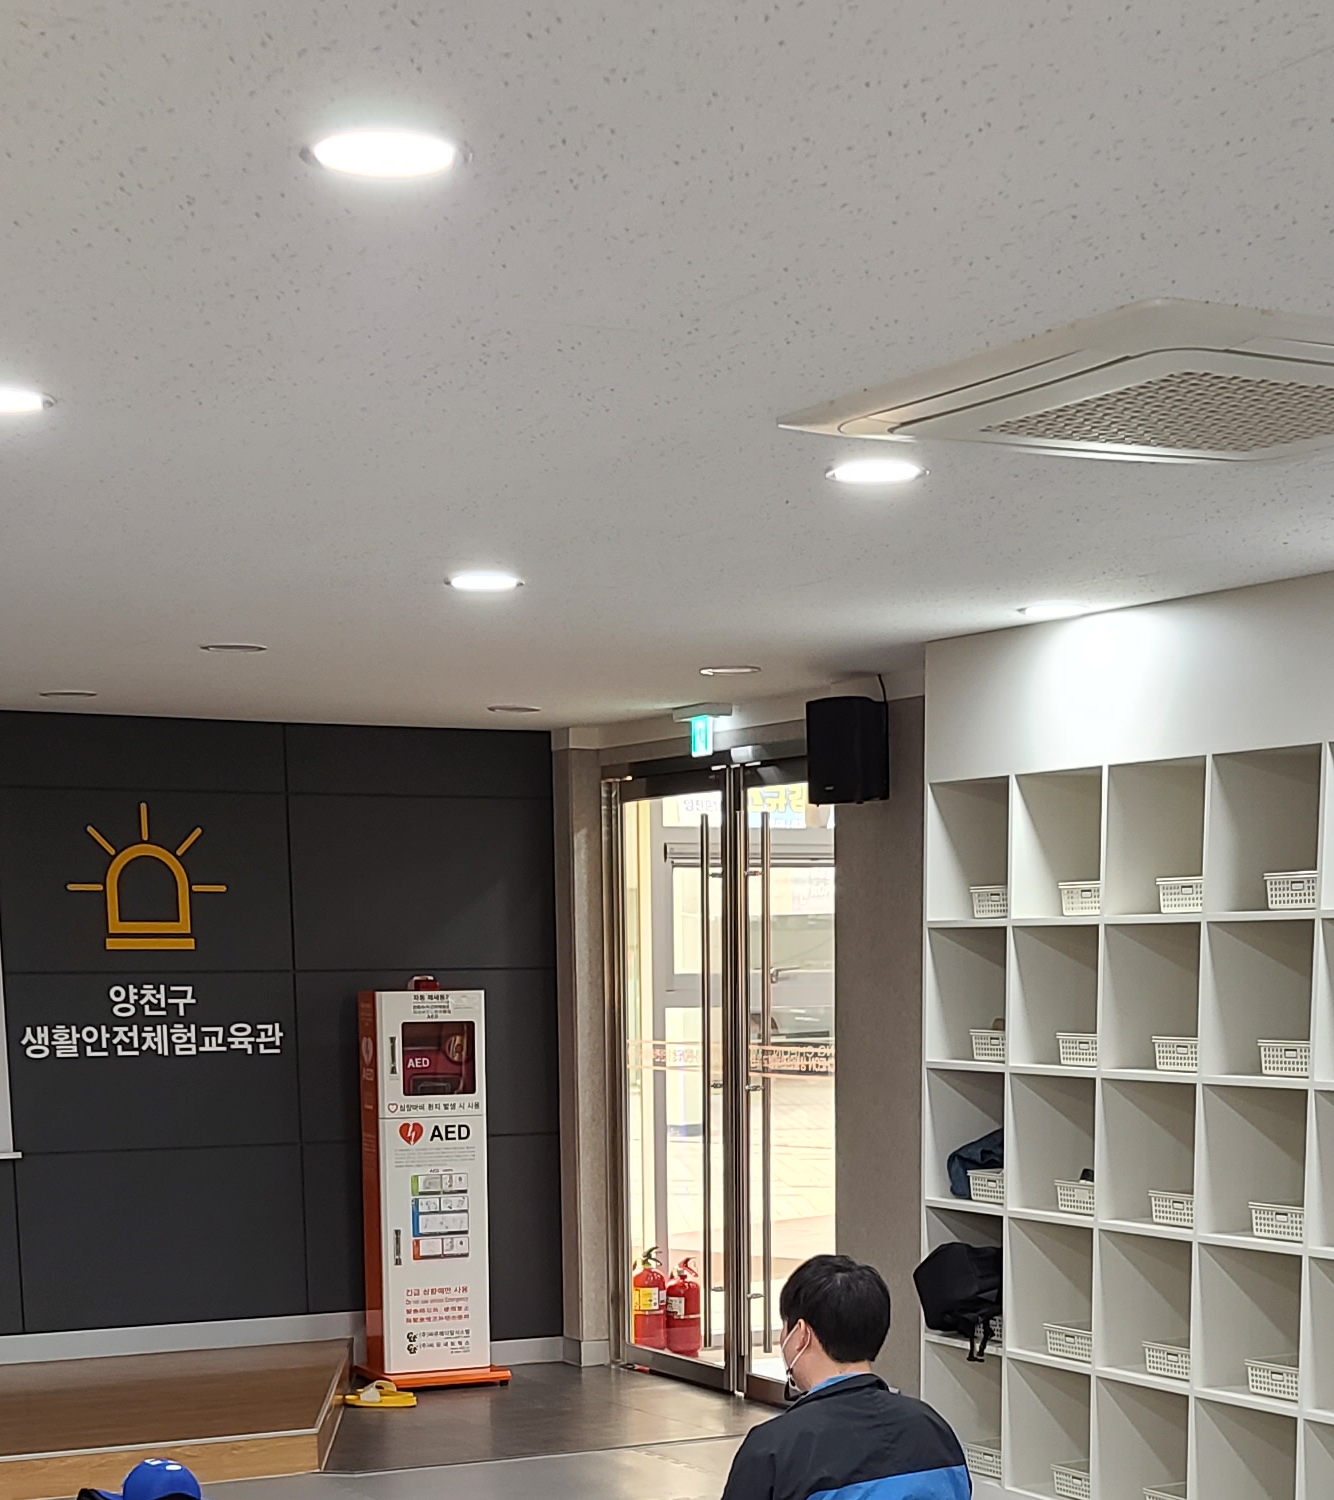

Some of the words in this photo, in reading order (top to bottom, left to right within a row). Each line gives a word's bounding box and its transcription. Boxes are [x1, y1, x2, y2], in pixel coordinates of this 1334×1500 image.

[109, 984, 196, 1018] 양천구
[20, 1022, 284, 1059] 생활안전체험교육관
[407, 1057, 430, 1069] AED
[459, 1102, 465, 1110] 시
[429, 1124, 471, 1142] AED
